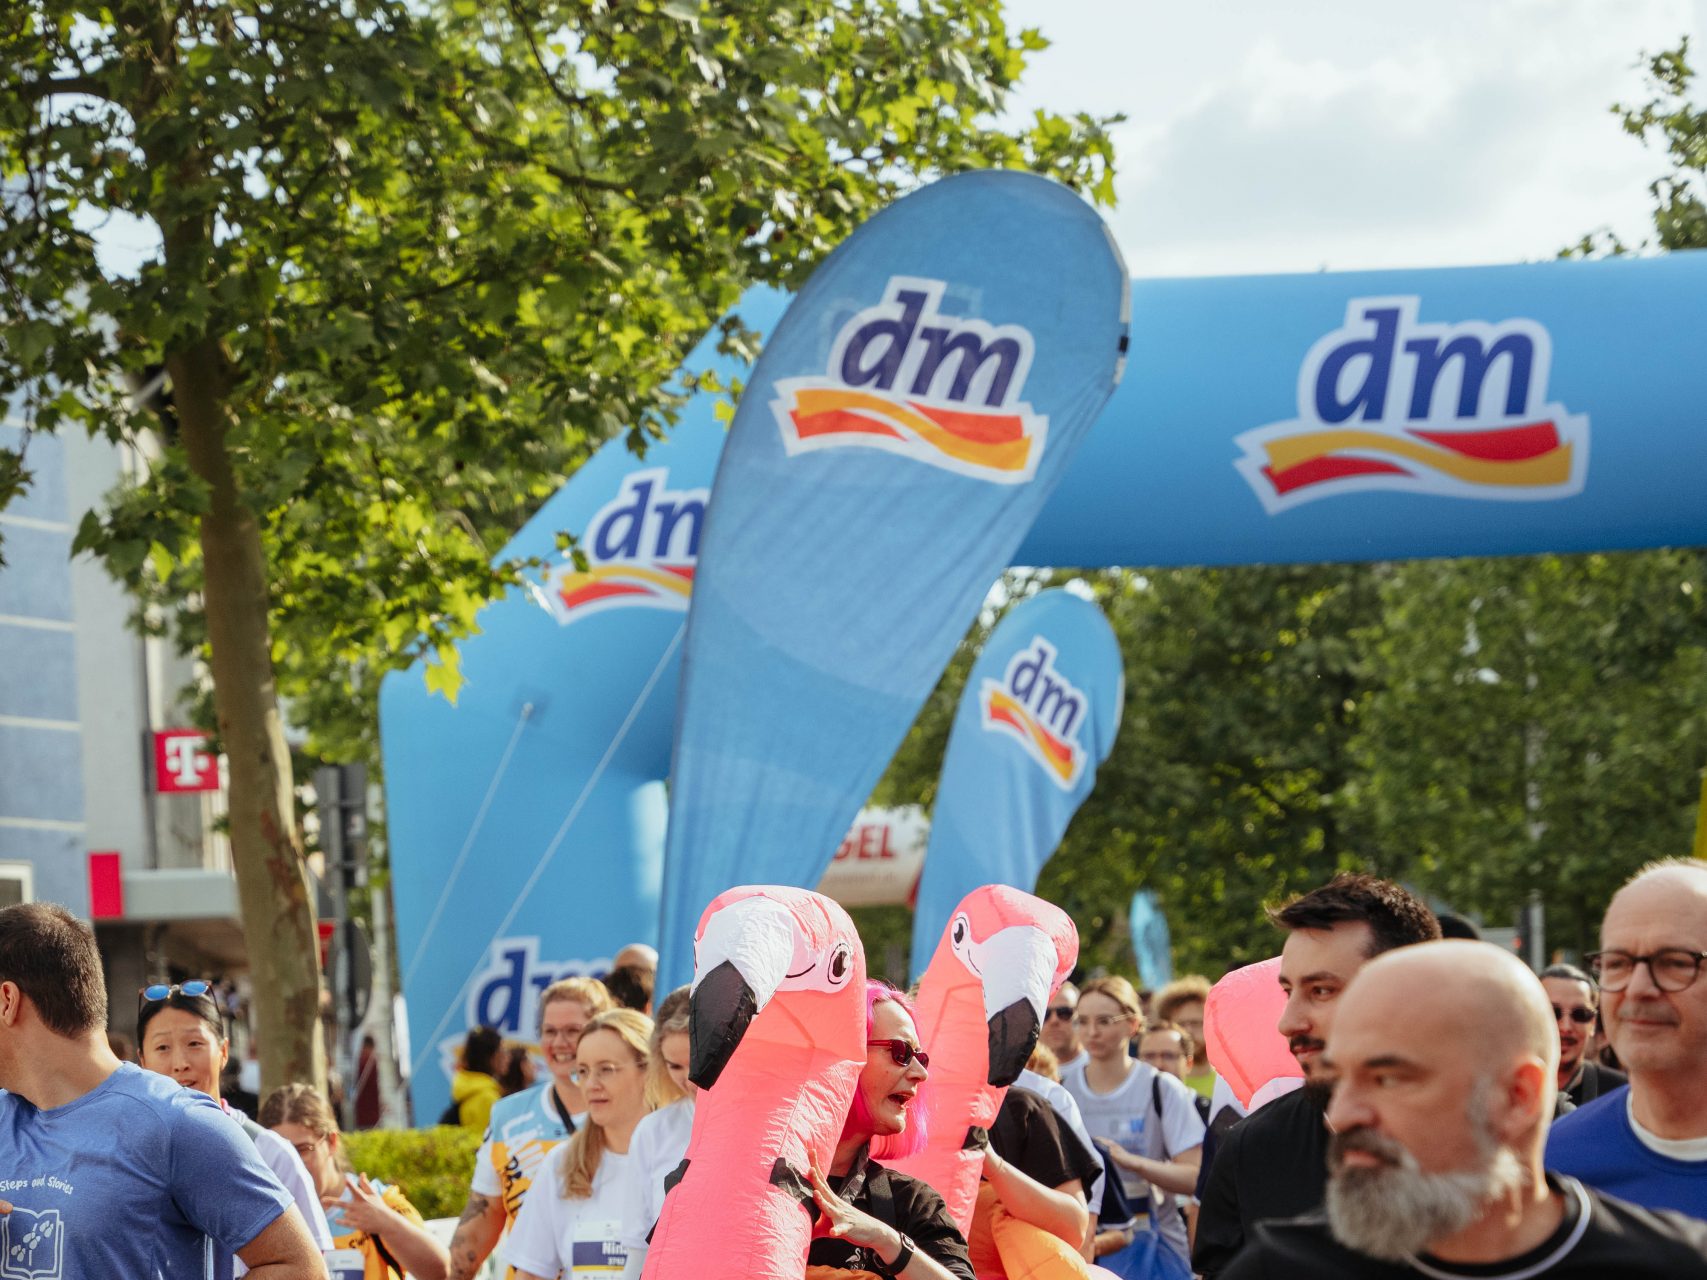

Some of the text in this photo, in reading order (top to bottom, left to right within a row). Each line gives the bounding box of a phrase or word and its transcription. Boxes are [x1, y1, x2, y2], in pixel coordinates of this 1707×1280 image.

[842, 288, 1021, 409] dm
[1314, 307, 1534, 426] dm
[1011, 646, 1079, 737] dm
[0, 1179, 28, 1193] Steps
[47, 1176, 74, 1195] Stories
